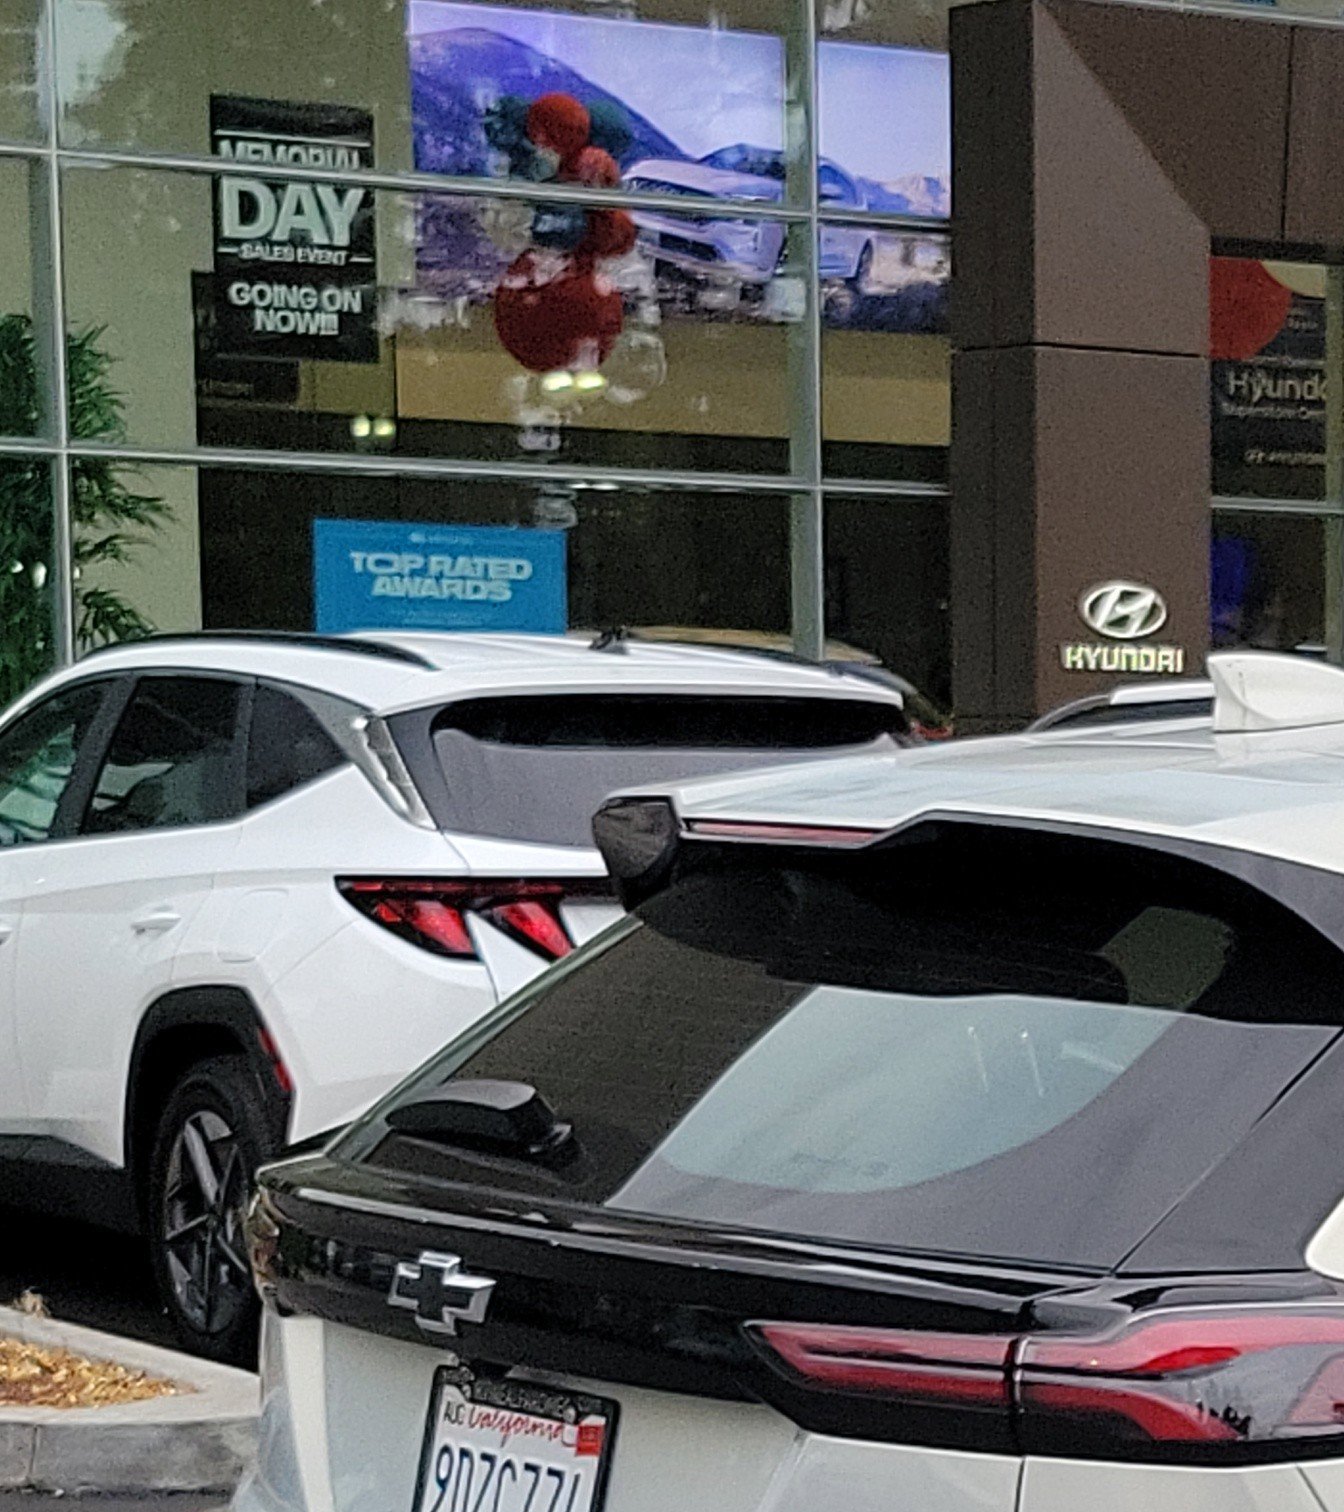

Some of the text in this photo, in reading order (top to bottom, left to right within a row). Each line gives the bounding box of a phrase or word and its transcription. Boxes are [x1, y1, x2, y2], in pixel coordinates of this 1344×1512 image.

[221, 176, 365, 247] DAY
[238, 242, 348, 266] SALES EVENT
[228, 281, 363, 313] GOING ON
[350, 551, 533, 580] TOP RATED
[371, 575, 513, 602] AWARDS
[1064, 645, 1185, 673] HYUNDAI
[467, 1406, 566, 1448] California
